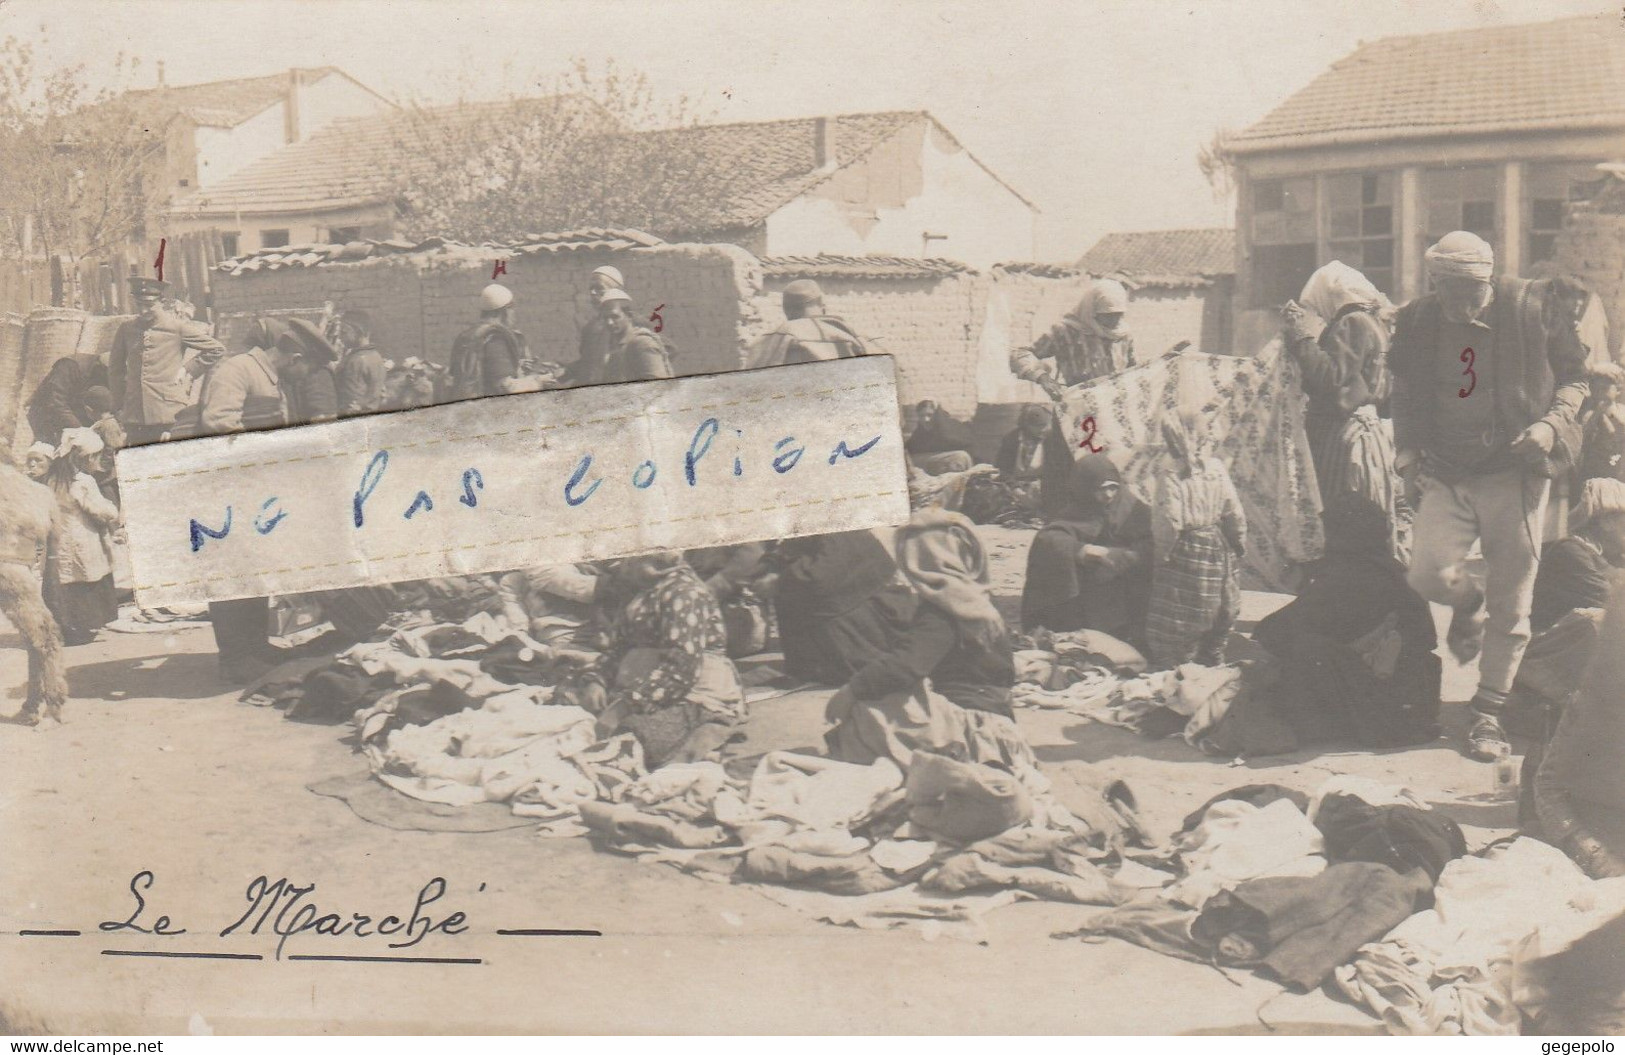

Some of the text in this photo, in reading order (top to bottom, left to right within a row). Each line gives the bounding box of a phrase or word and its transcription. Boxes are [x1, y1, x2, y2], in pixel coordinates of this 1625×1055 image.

[153, 237, 167, 281] 1
[649, 302, 666, 333] 5
[1457, 346, 1477, 398] 3
[1078, 416, 1104, 454] 2
[99, 870, 487, 960] Le Marché
